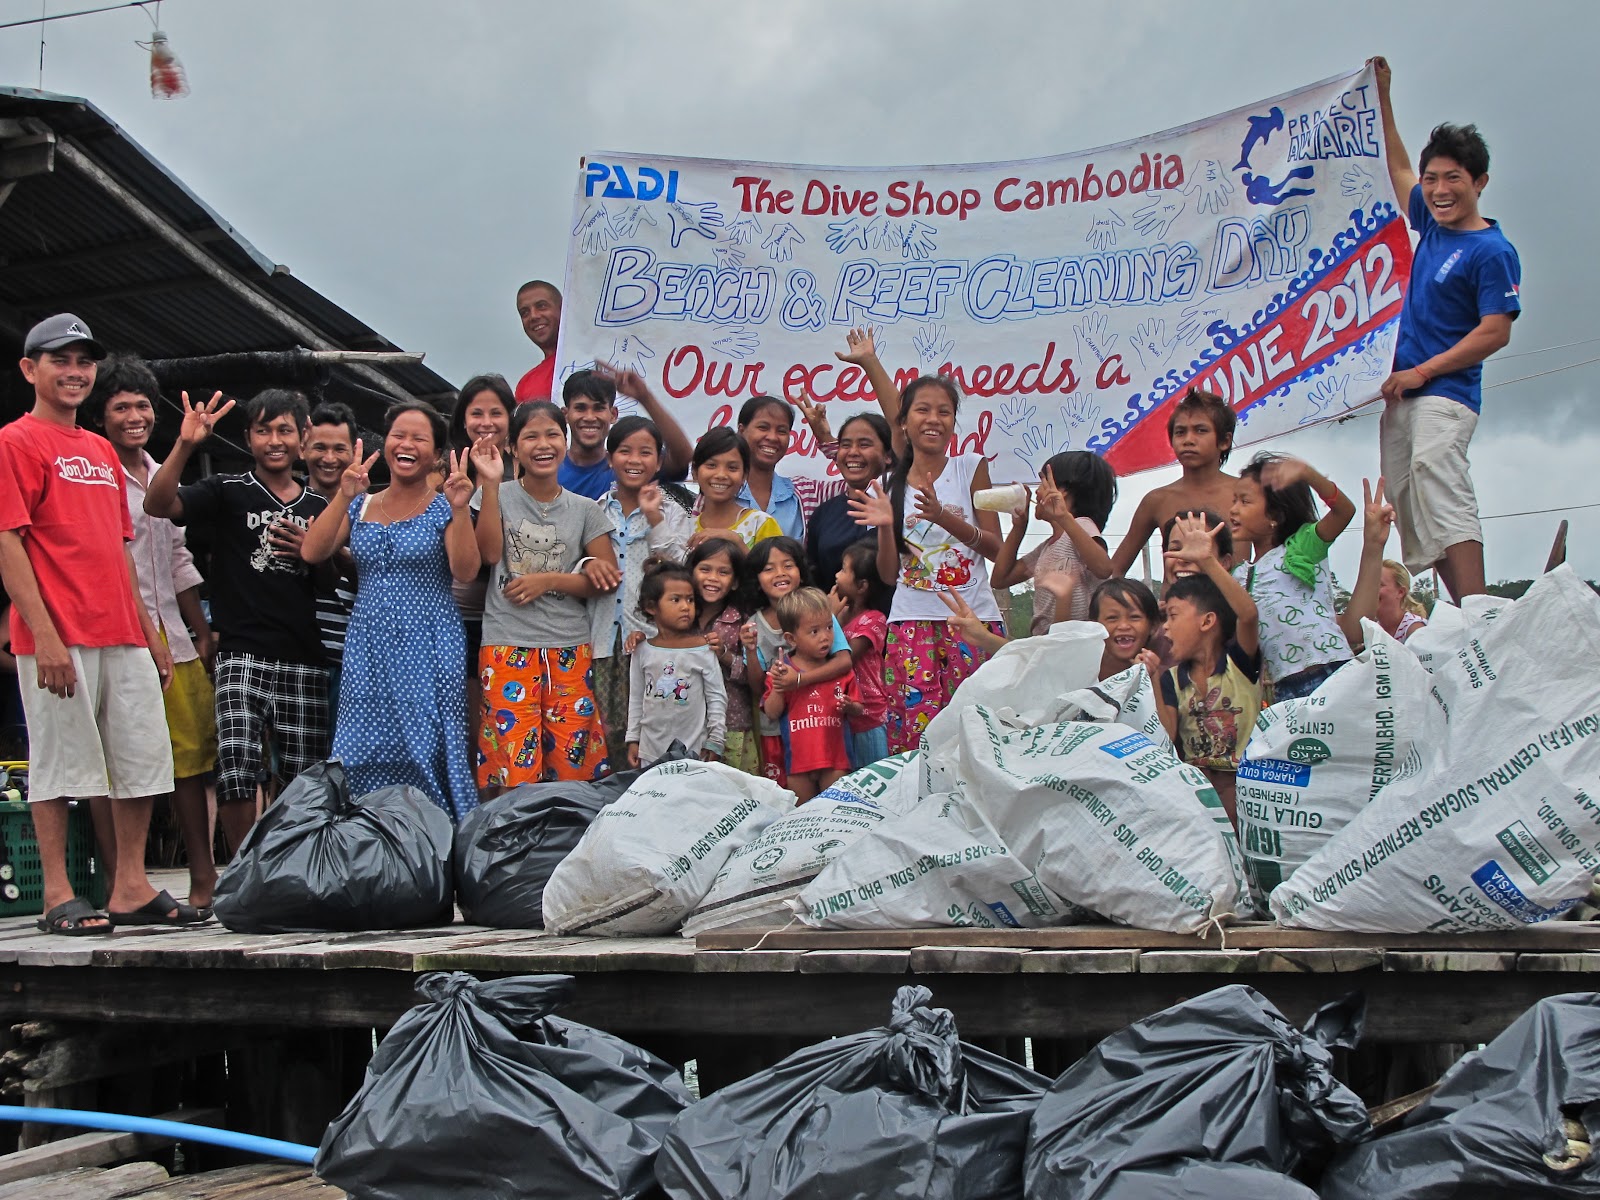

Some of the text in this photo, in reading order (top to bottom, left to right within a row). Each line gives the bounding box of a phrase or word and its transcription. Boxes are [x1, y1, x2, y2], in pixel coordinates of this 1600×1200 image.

[1287, 109, 1379, 162] AWARE
[585, 162, 679, 203] PADI
[732, 176, 794, 215] The
[801, 179, 877, 217] Dive
[885, 180, 981, 220] Shop
[994, 152, 1185, 212] Cambodia
[595, 204, 1313, 332] BEACH & REEF CLEANING DAY
[1190, 242, 1402, 405] UNE 2012
[662, 345, 767, 398] Our
[938, 341, 1081, 397] needs
[1095, 354, 1131, 390] a
[1376, 674, 1391, 700] IGM
[807, 703, 825, 714] Fly
[789, 715, 842, 732] Emirates
[1263, 770, 1295, 783] HARGA
[1277, 761, 1303, 772] OLEH
[1476, 742, 1541, 797] CENTRAL
[1249, 788, 1292, 802] REFINED
[1420, 785, 1480, 831] SUGARS
[714, 802, 750, 837] REFINERY
[786, 817, 827, 825] REFINERY
[793, 827, 821, 835] SHAH
[1274, 806, 1322, 829] GULA
[780, 832, 825, 842] MALAYSIA.
[1066, 784, 1117, 827] REFINERY
[1113, 823, 1140, 852] SDN.
[1136, 847, 1160, 877] BHD.
[1158, 865, 1189, 896] IGM
[1245, 825, 1282, 857] IGM
[1362, 816, 1423, 876] REFINERY
[826, 890, 857, 912] IGM
[853, 879, 884, 902] BHD.
